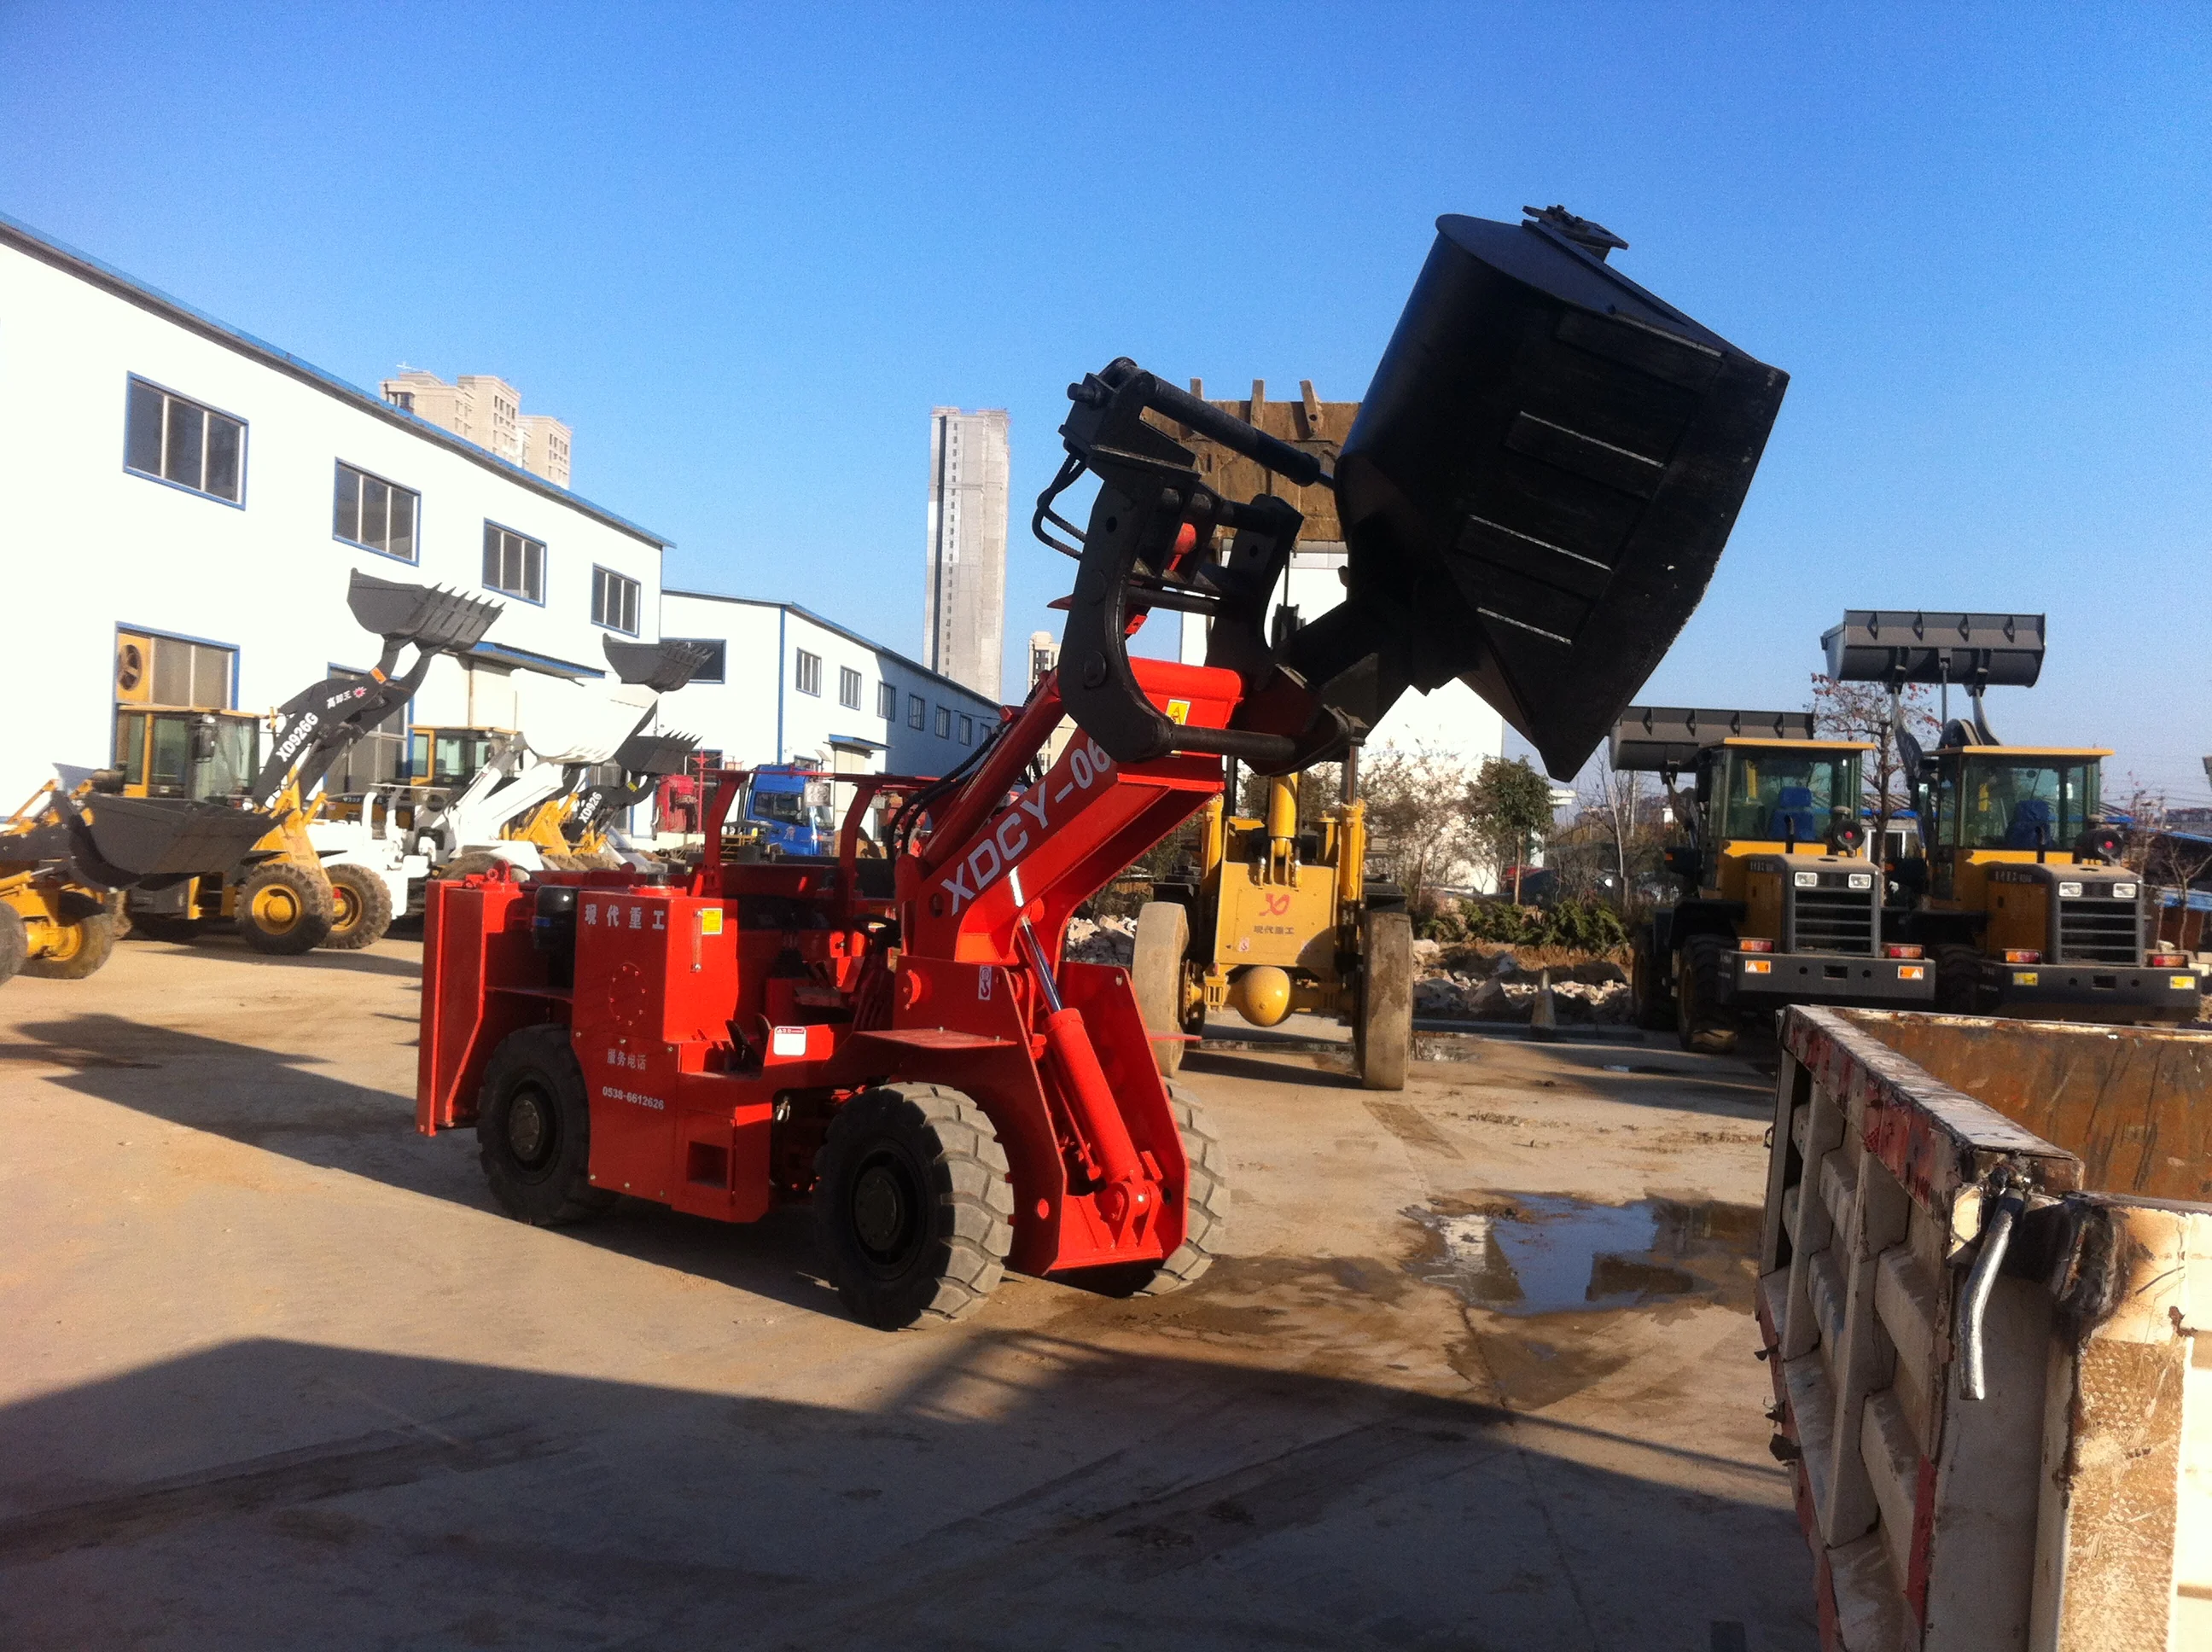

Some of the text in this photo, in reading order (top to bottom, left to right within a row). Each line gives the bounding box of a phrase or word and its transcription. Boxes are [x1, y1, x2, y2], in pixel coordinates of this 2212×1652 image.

[276, 713, 319, 762] XD926G
[579, 791, 602, 823] XD926
[940, 736, 1111, 916] XDCY-06
[584, 903, 665, 930] 现代重工
[607, 1048, 647, 1070] 服务电话
[602, 1085, 665, 1110] 0538-6612626
